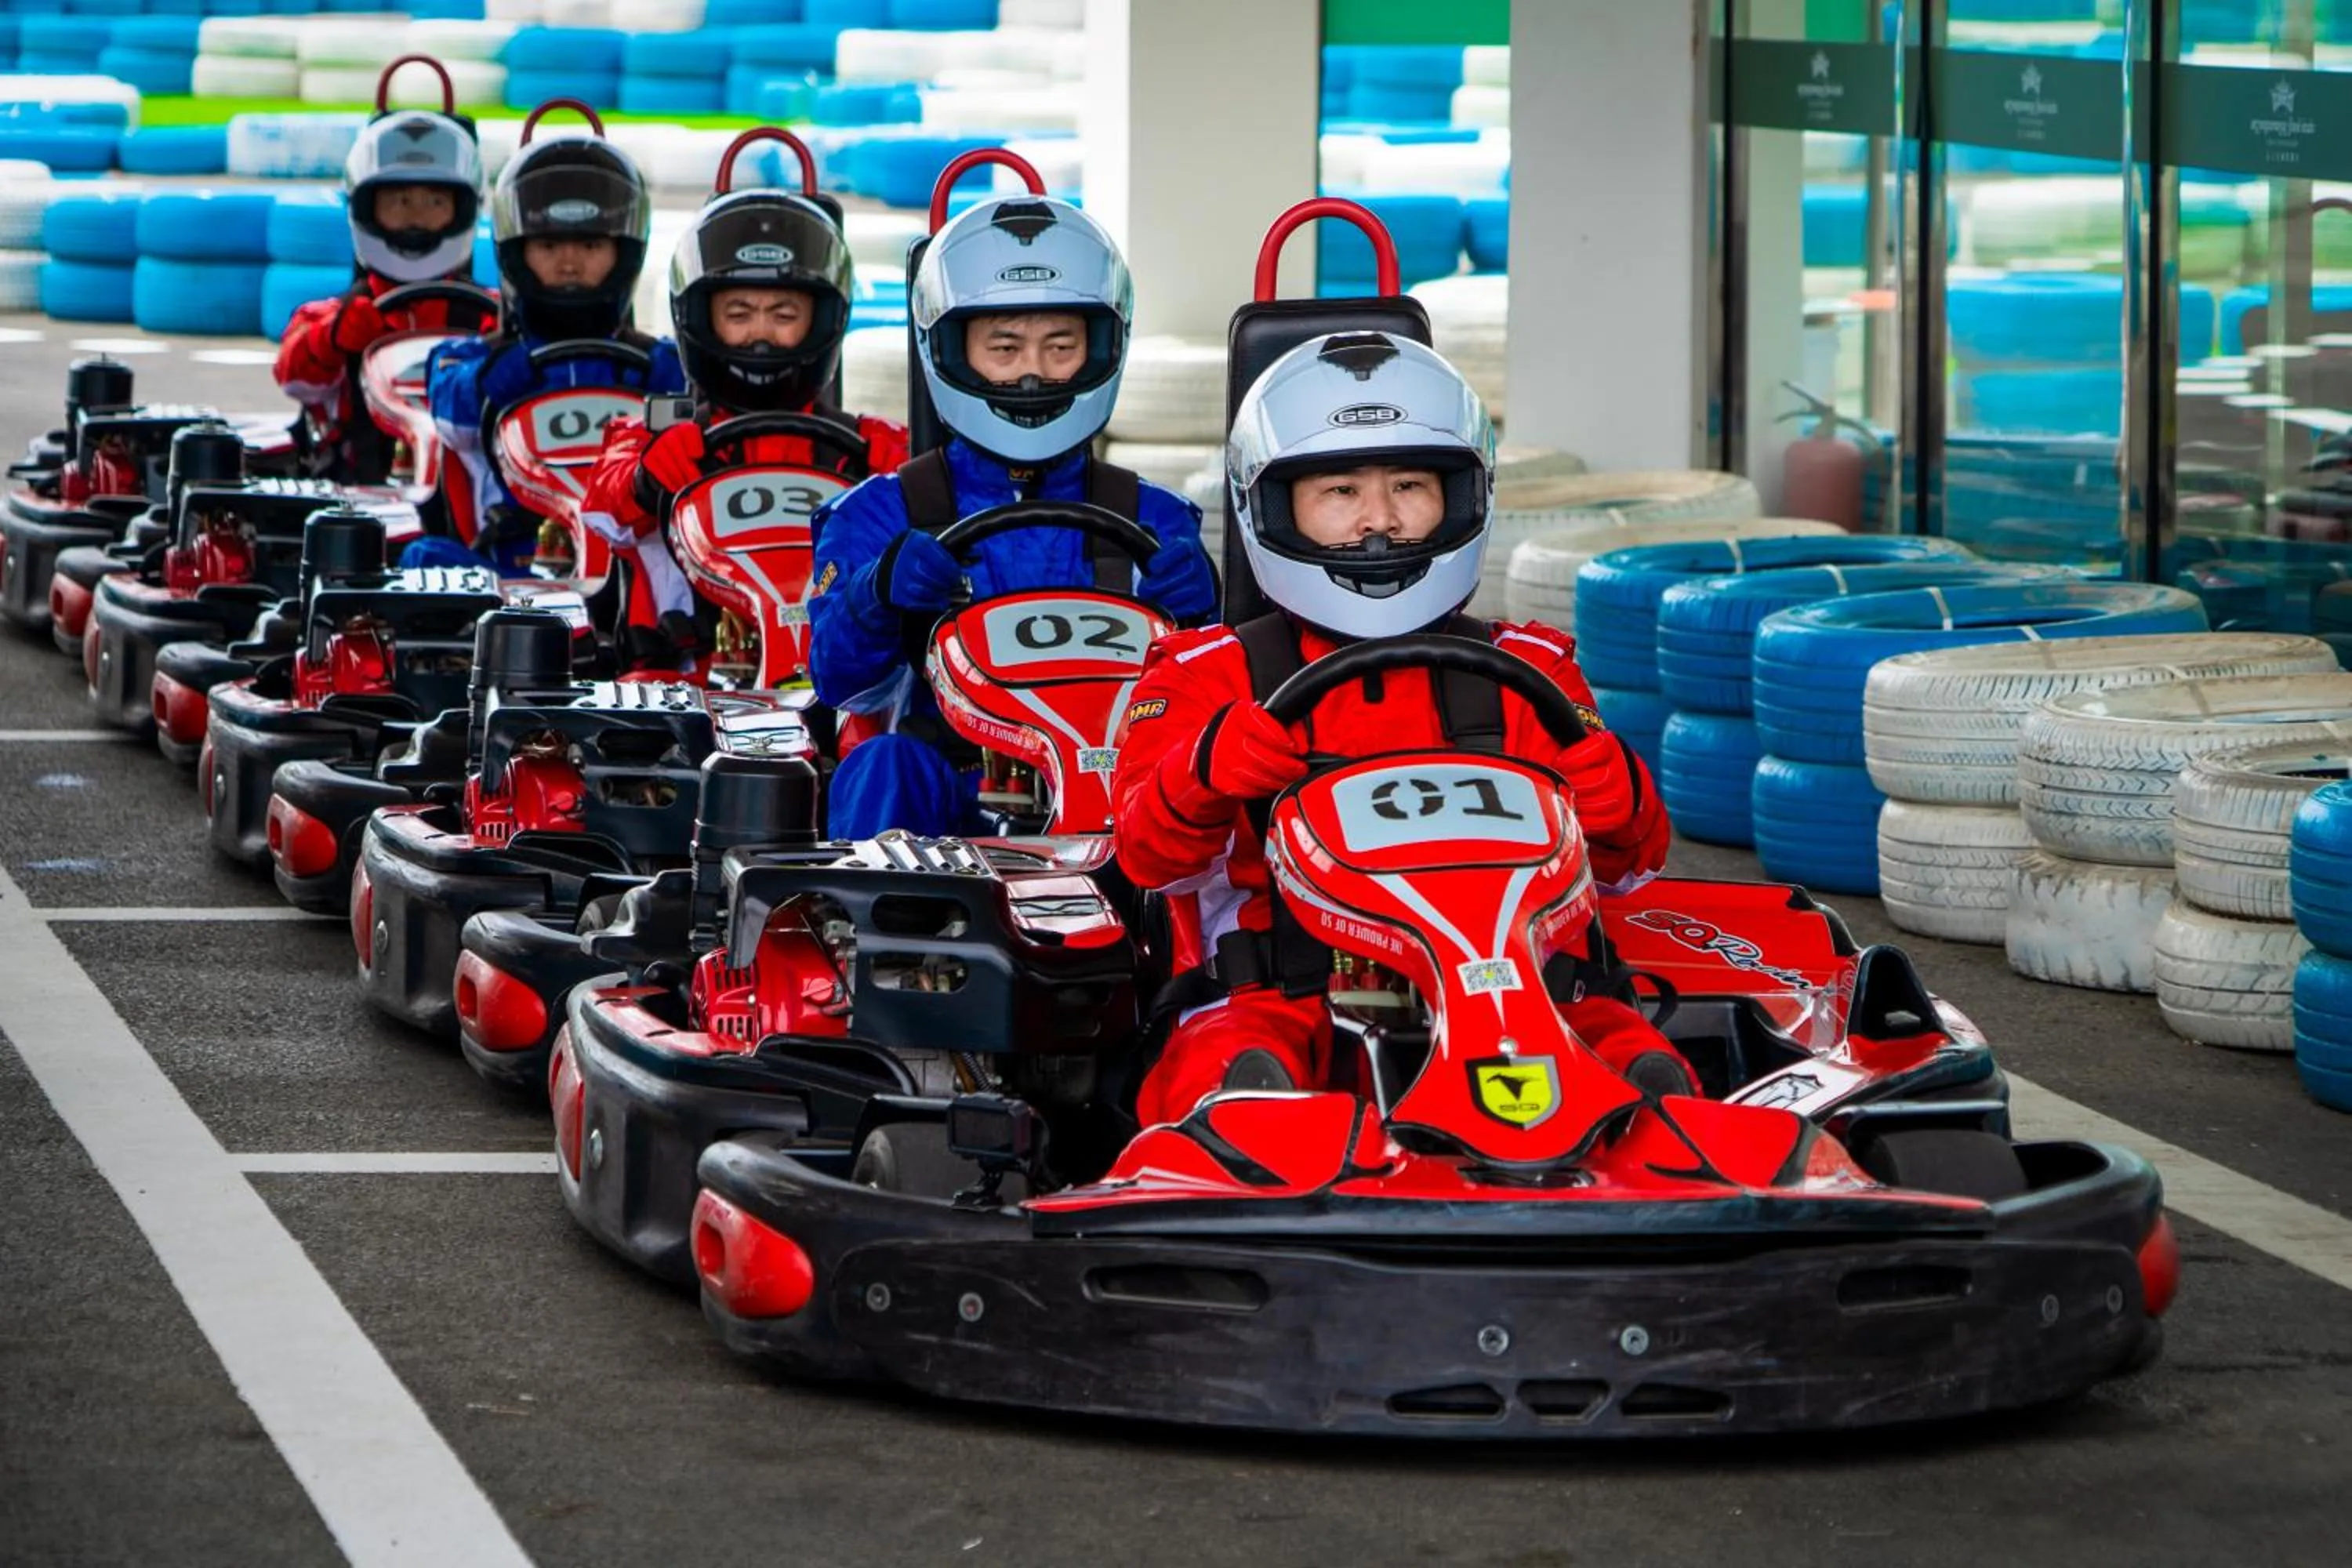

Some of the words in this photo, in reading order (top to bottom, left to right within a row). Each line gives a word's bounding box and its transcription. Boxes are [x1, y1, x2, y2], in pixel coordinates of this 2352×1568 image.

[727, 485, 824, 520] 03
[1015, 614, 1138, 653] 02
[1371, 779, 1524, 821] 01
[1334, 917, 1347, 933] OF
